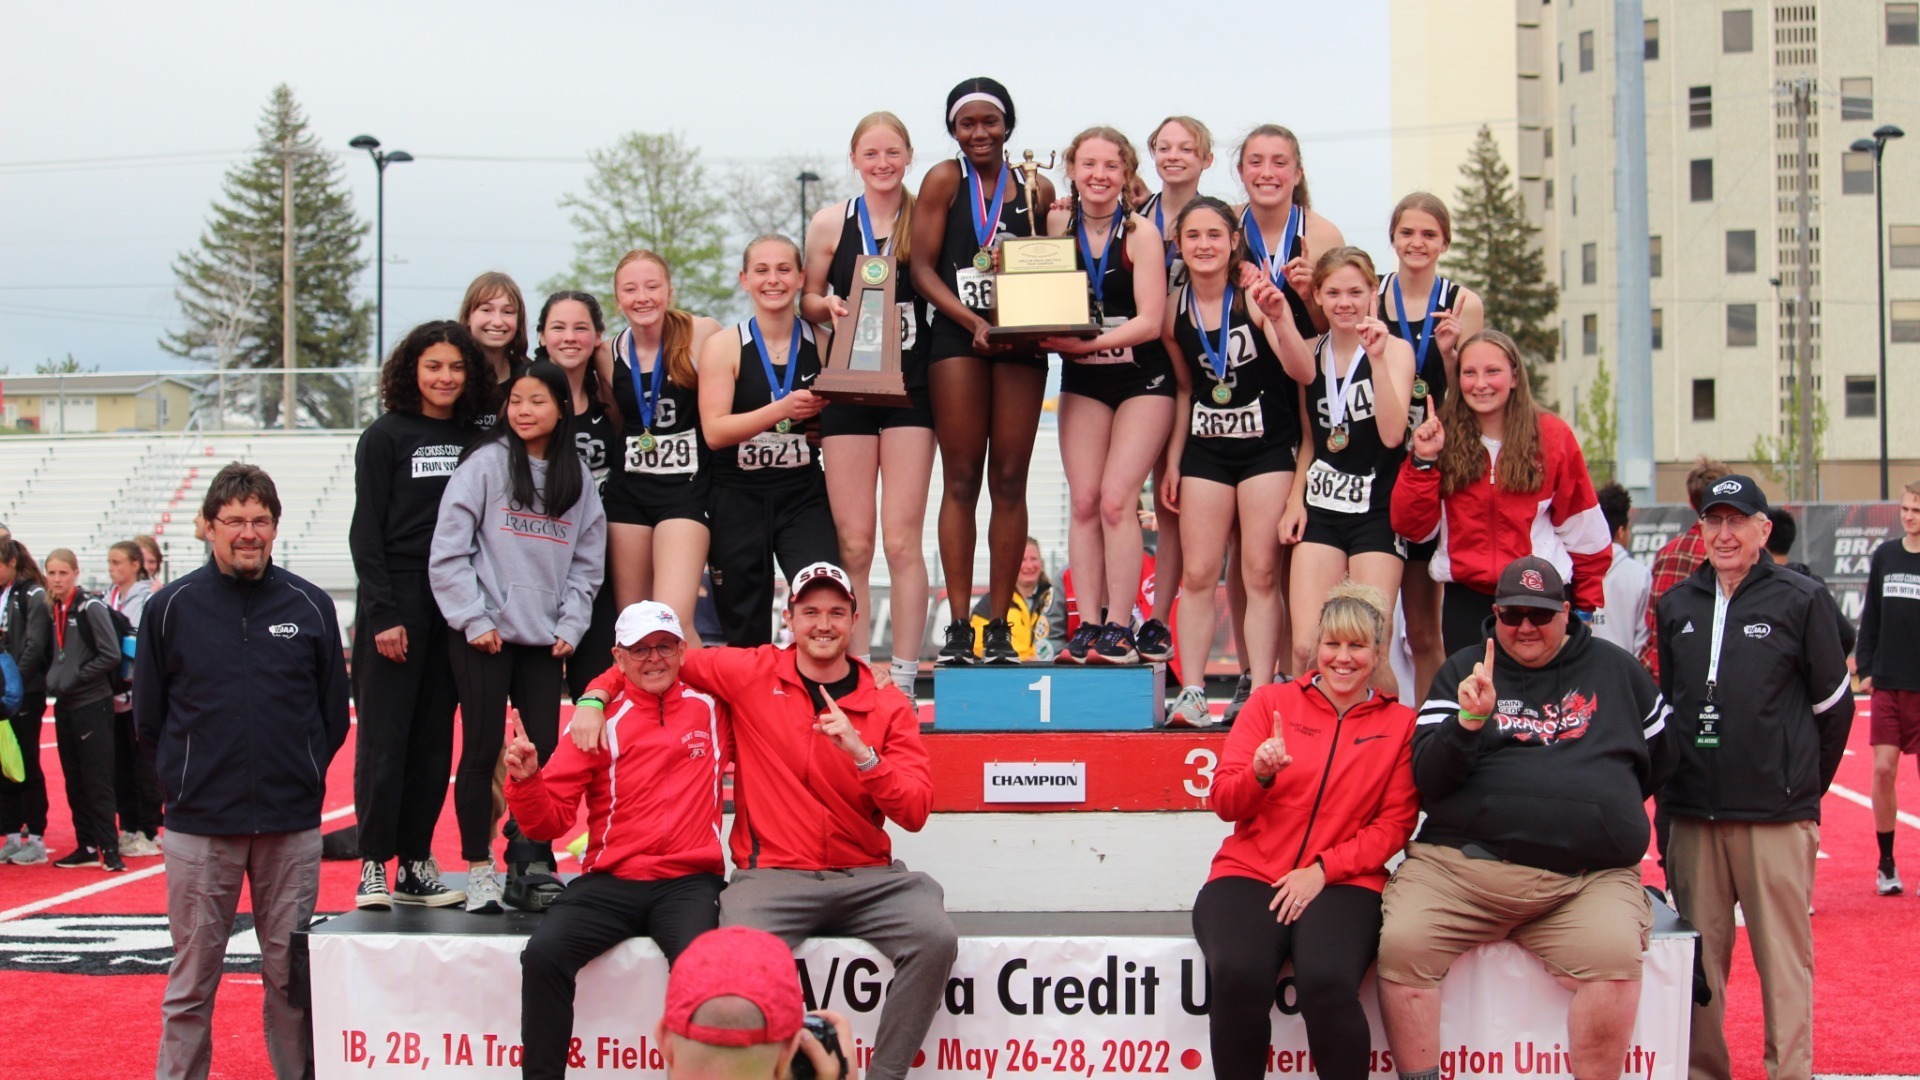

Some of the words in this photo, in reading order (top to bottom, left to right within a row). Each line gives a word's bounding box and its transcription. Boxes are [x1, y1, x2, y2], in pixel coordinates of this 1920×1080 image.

[1229, 331, 1253, 363] 2
[1354, 384, 1372, 415] 4
[1197, 411, 1256, 435] 3620
[575, 432, 605, 468] SG
[630, 439, 690, 467] 3629
[742, 438, 802, 467] 3621
[422, 462, 442, 471] RUN
[1310, 471, 1364, 503] 3628
[1631, 534, 1668, 552] BO
[1834, 538, 1884, 556] BRA
[800, 567, 843, 583] SGS
[1834, 556, 1871, 574] KA
[1028, 675, 1051, 723] 1
[992, 775, 1078, 786] CHAMPION
[1183, 748, 1217, 797] 3
[997, 955, 1160, 1016] Credit
[342, 1030, 376, 1069] 1B,
[386, 1032, 430, 1070] 2B,
[443, 1033, 473, 1066] 1A
[483, 1034, 525, 1067] Tra
[567, 1037, 586, 1068] &
[938, 1038, 998, 1079] May
[1006, 1039, 1095, 1078] 26-28,
[1102, 1040, 1170, 1073] 2022
